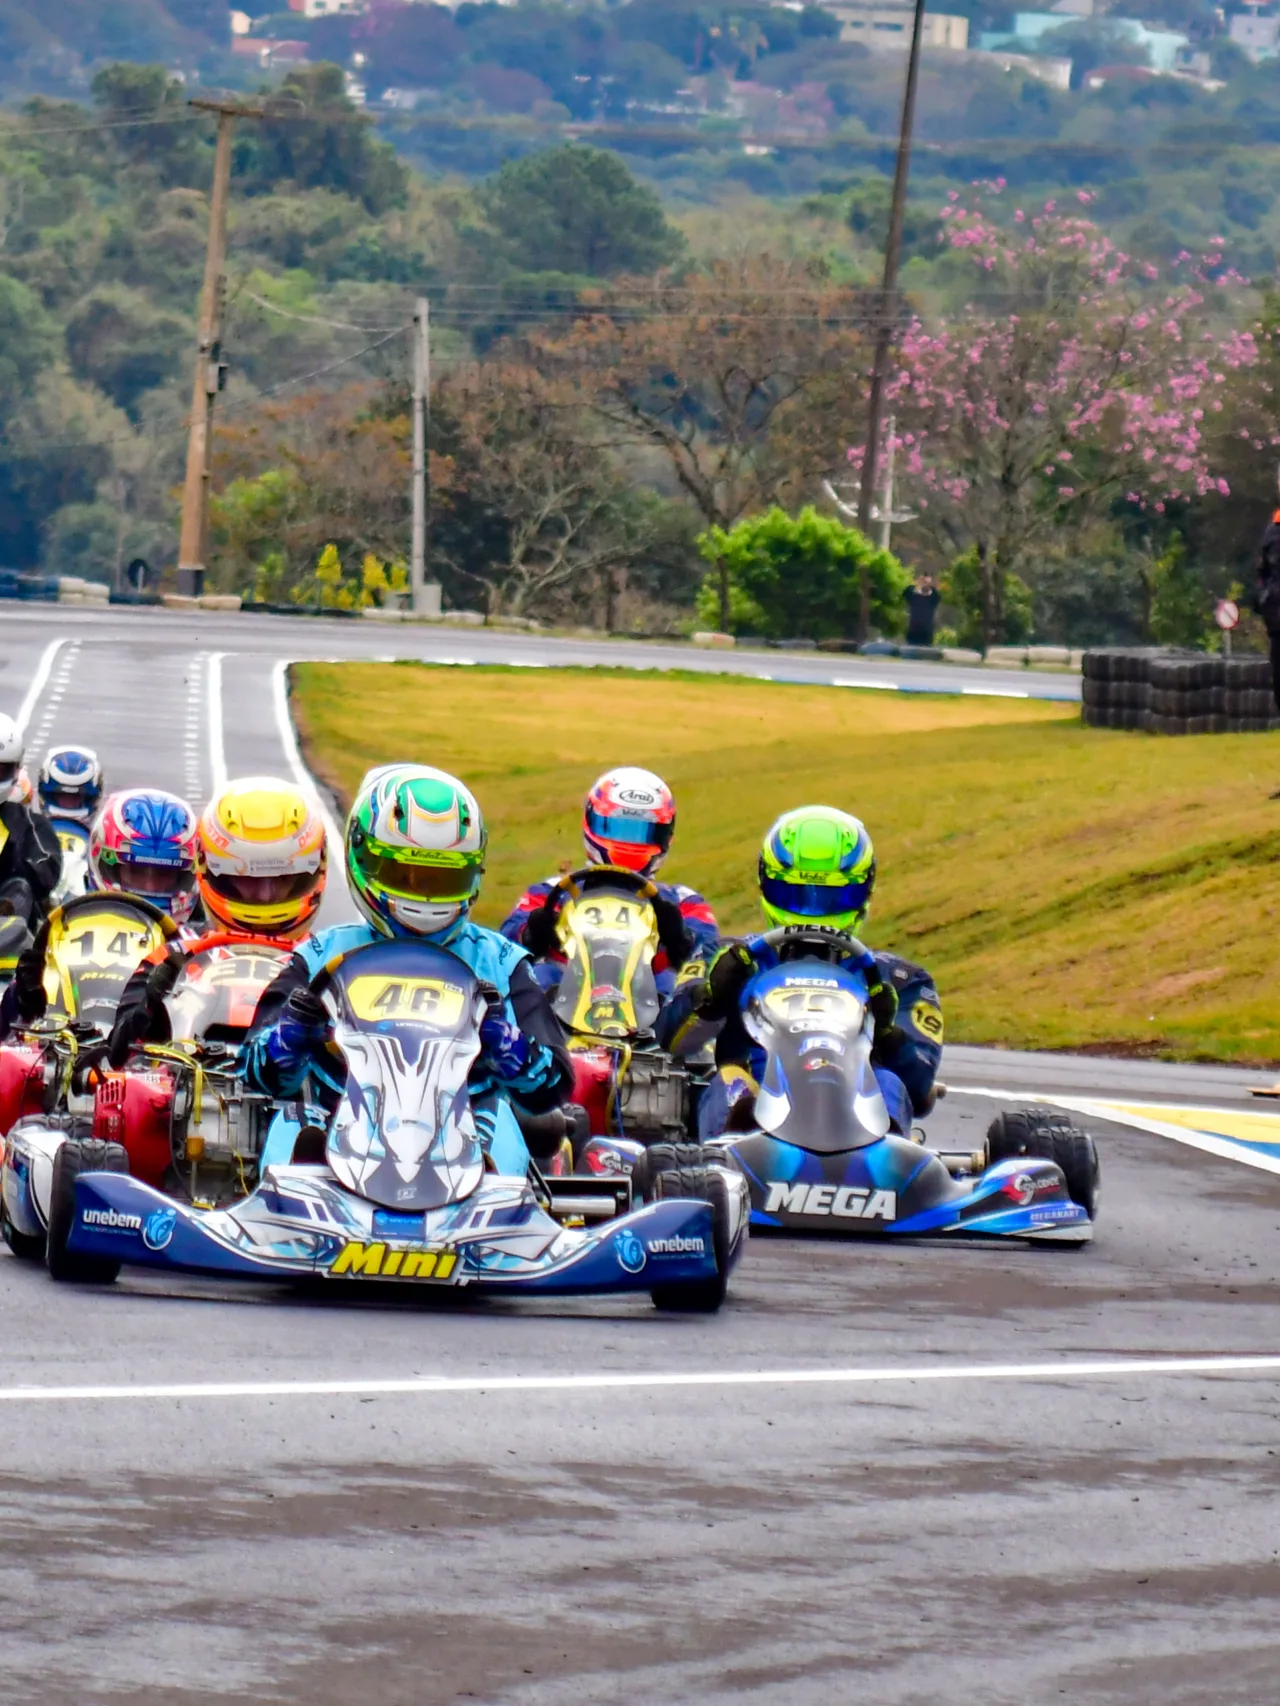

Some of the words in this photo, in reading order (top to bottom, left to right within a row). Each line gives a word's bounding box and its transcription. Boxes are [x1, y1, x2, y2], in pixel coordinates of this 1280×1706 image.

[628, 790, 651, 801] Arai
[584, 906, 632, 925] 34
[784, 924, 852, 942] MEGA
[70, 930, 130, 957] 14
[785, 977, 839, 988] MEGA
[371, 983, 443, 1016] 46
[593, 1007, 615, 1019] M
[916, 1008, 943, 1035] 19
[765, 1182, 897, 1221] MEGA
[83, 1208, 142, 1229] unebem
[648, 1234, 705, 1253] unebem
[331, 1241, 458, 1280] Mini
